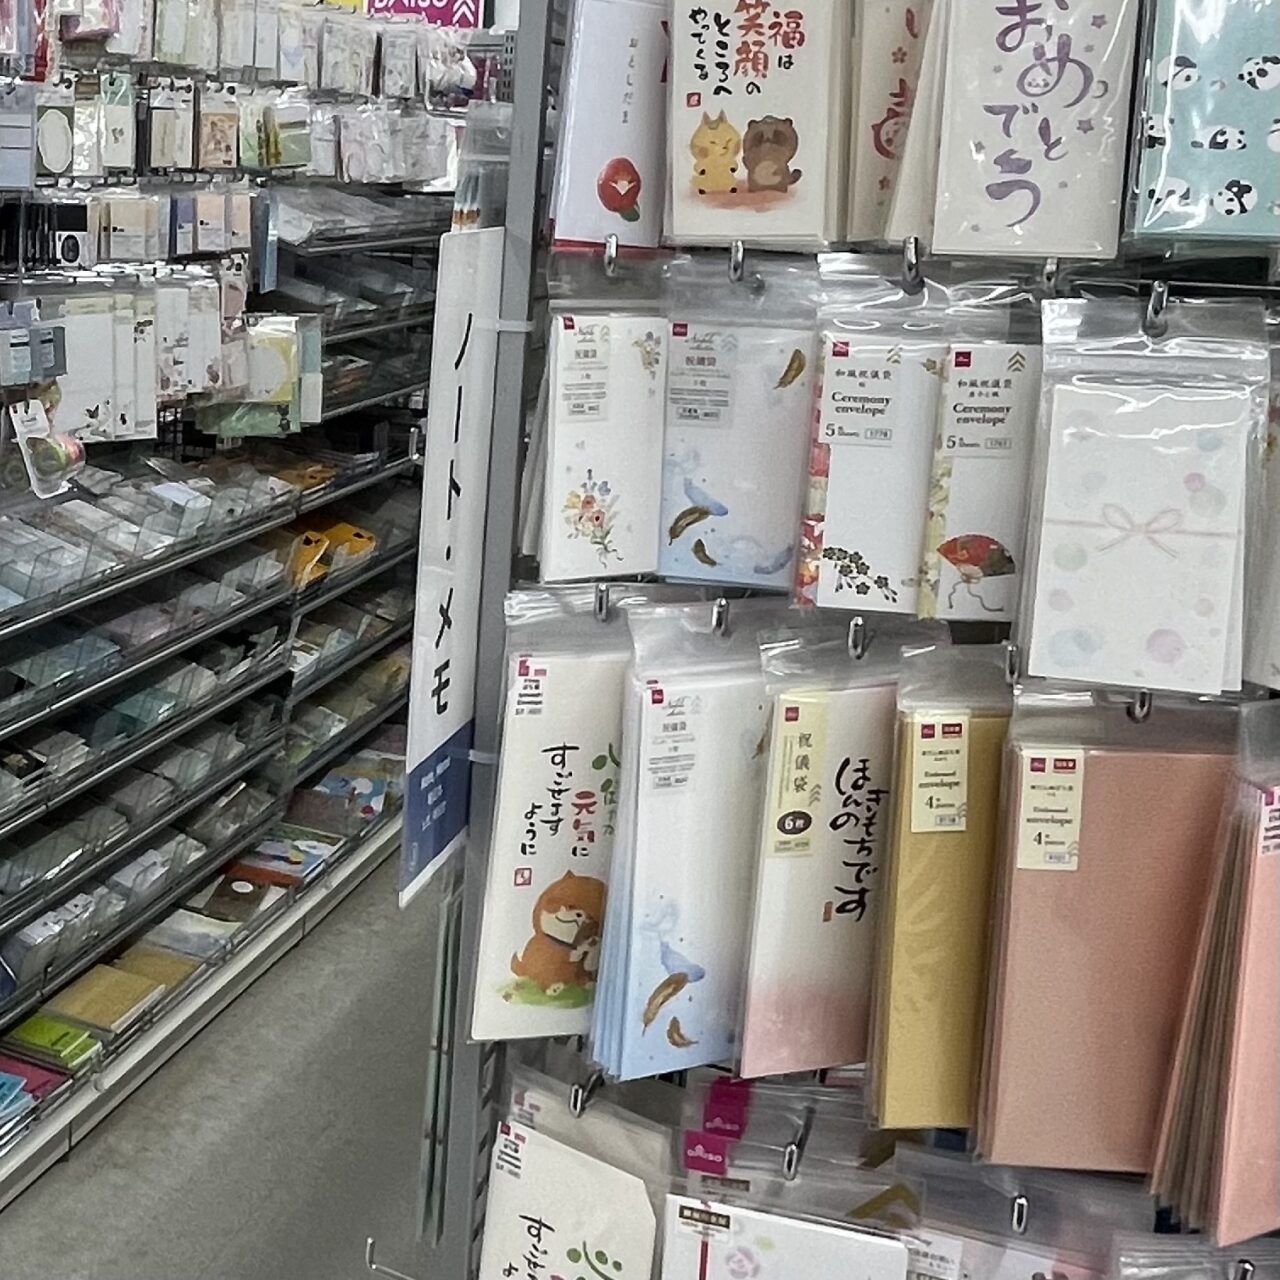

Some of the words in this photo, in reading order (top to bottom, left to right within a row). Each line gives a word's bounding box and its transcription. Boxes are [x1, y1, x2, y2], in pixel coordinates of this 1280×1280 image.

[689, 6, 710, 81] やってくる
[713, 12, 733, 96] ところへ
[768, 10, 806, 70] 福は
[831, 391, 892, 406] Ceremony
[834, 404, 887, 418] envelope
[953, 402, 1012, 417] Ceremony
[825, 423, 836, 437] 5
[956, 414, 1007, 428] envelope
[946, 435, 956, 449] 5
[520, 802, 543, 857] ように
[571, 790, 598, 857] 元気に
[519, 1213, 556, 1280] すごせ
